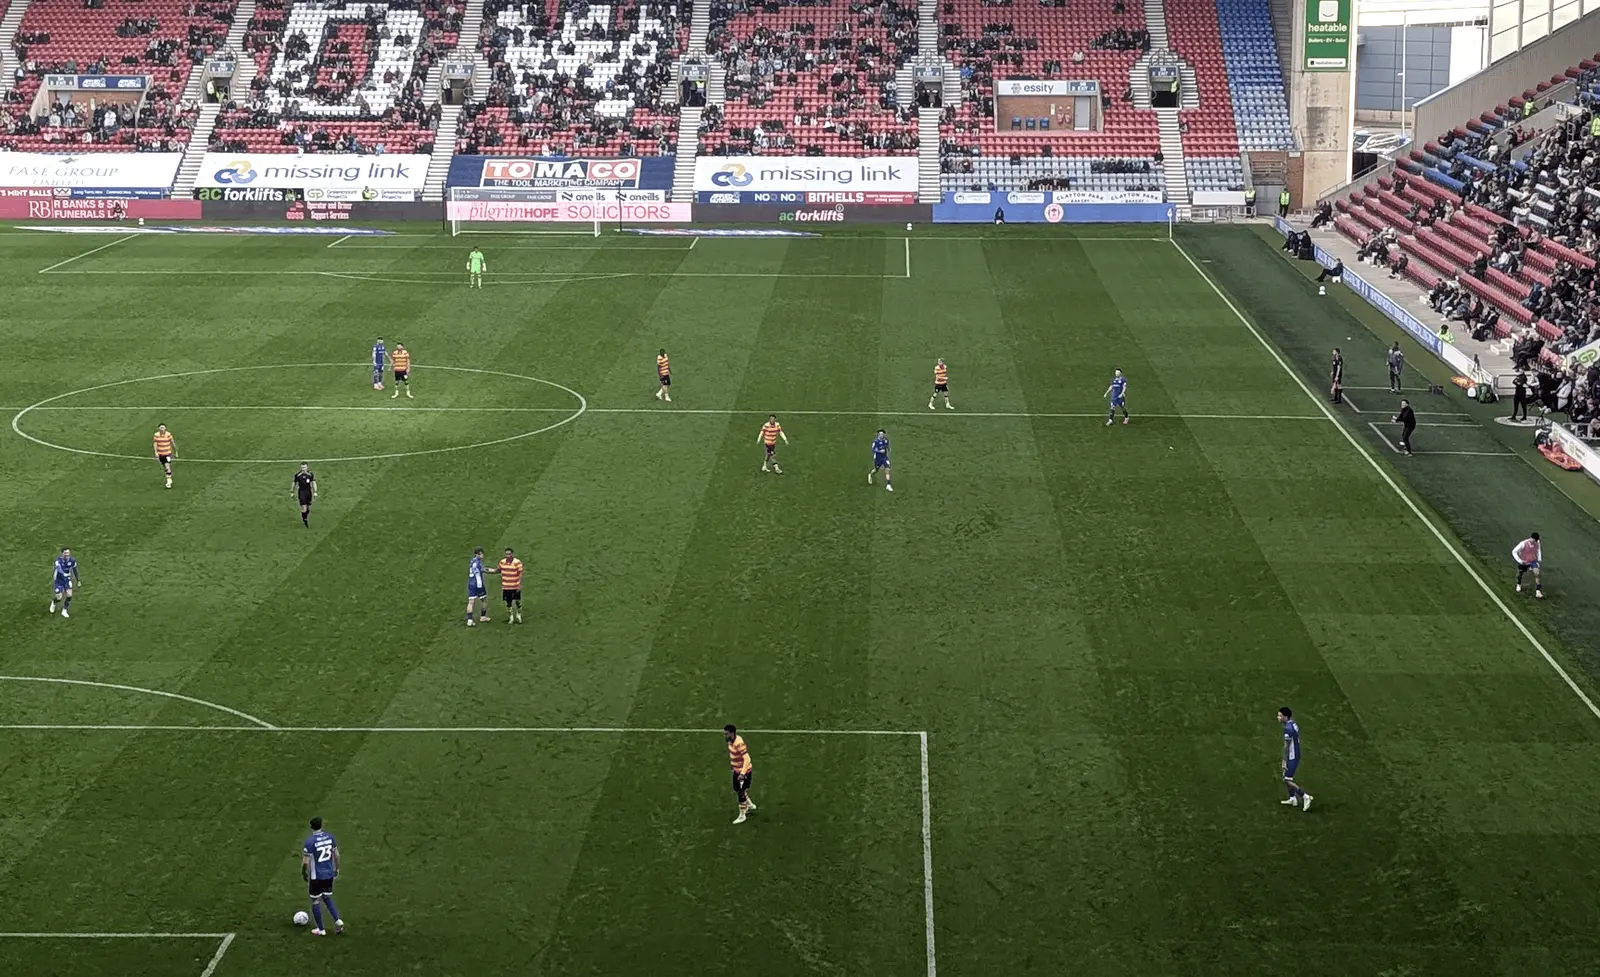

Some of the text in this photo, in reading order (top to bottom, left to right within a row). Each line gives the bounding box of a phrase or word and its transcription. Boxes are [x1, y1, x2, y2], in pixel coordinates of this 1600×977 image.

[1308, 23, 1347, 32] heatable
[1024, 83, 1054, 92] essity
[9, 166, 118, 177] FASE GROUP
[264, 163, 410, 181] missing link
[486, 162, 636, 178] TOMACO
[760, 166, 901, 184] missing link
[534, 179, 582, 187] MARKETING
[224, 188, 284, 200] forklifts
[576, 192, 606, 201] onells
[629, 192, 660, 201] oneills
[808, 192, 864, 202] BITHELLS
[28, 200, 51, 218] RB
[54, 200, 128, 209] R BANKS & SON
[54, 210, 105, 218] FUNERALS
[568, 205, 670, 219] SOLICTORS
[779, 210, 844, 221] ac forklifts
[316, 844, 332, 862] 23
